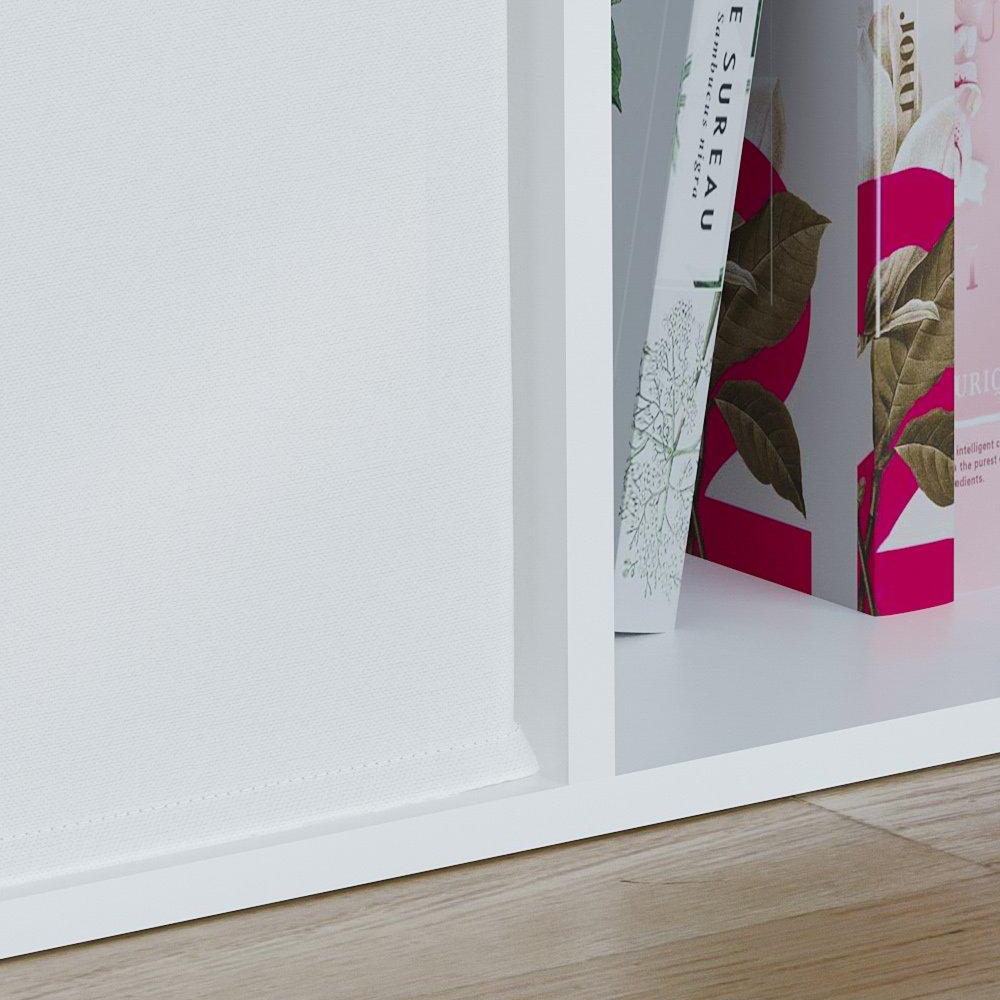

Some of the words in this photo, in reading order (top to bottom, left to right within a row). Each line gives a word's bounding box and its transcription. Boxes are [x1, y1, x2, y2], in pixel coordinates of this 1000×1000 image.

[702, 11, 725, 127] Sambucus
[899, 11, 915, 112] mor
[692, 137, 706, 199] nigra
[700, 51, 736, 231] SUREAU
[956, 439, 994, 456] intelligent
[960, 460, 972, 471] the
[974, 455, 996, 471] purest
